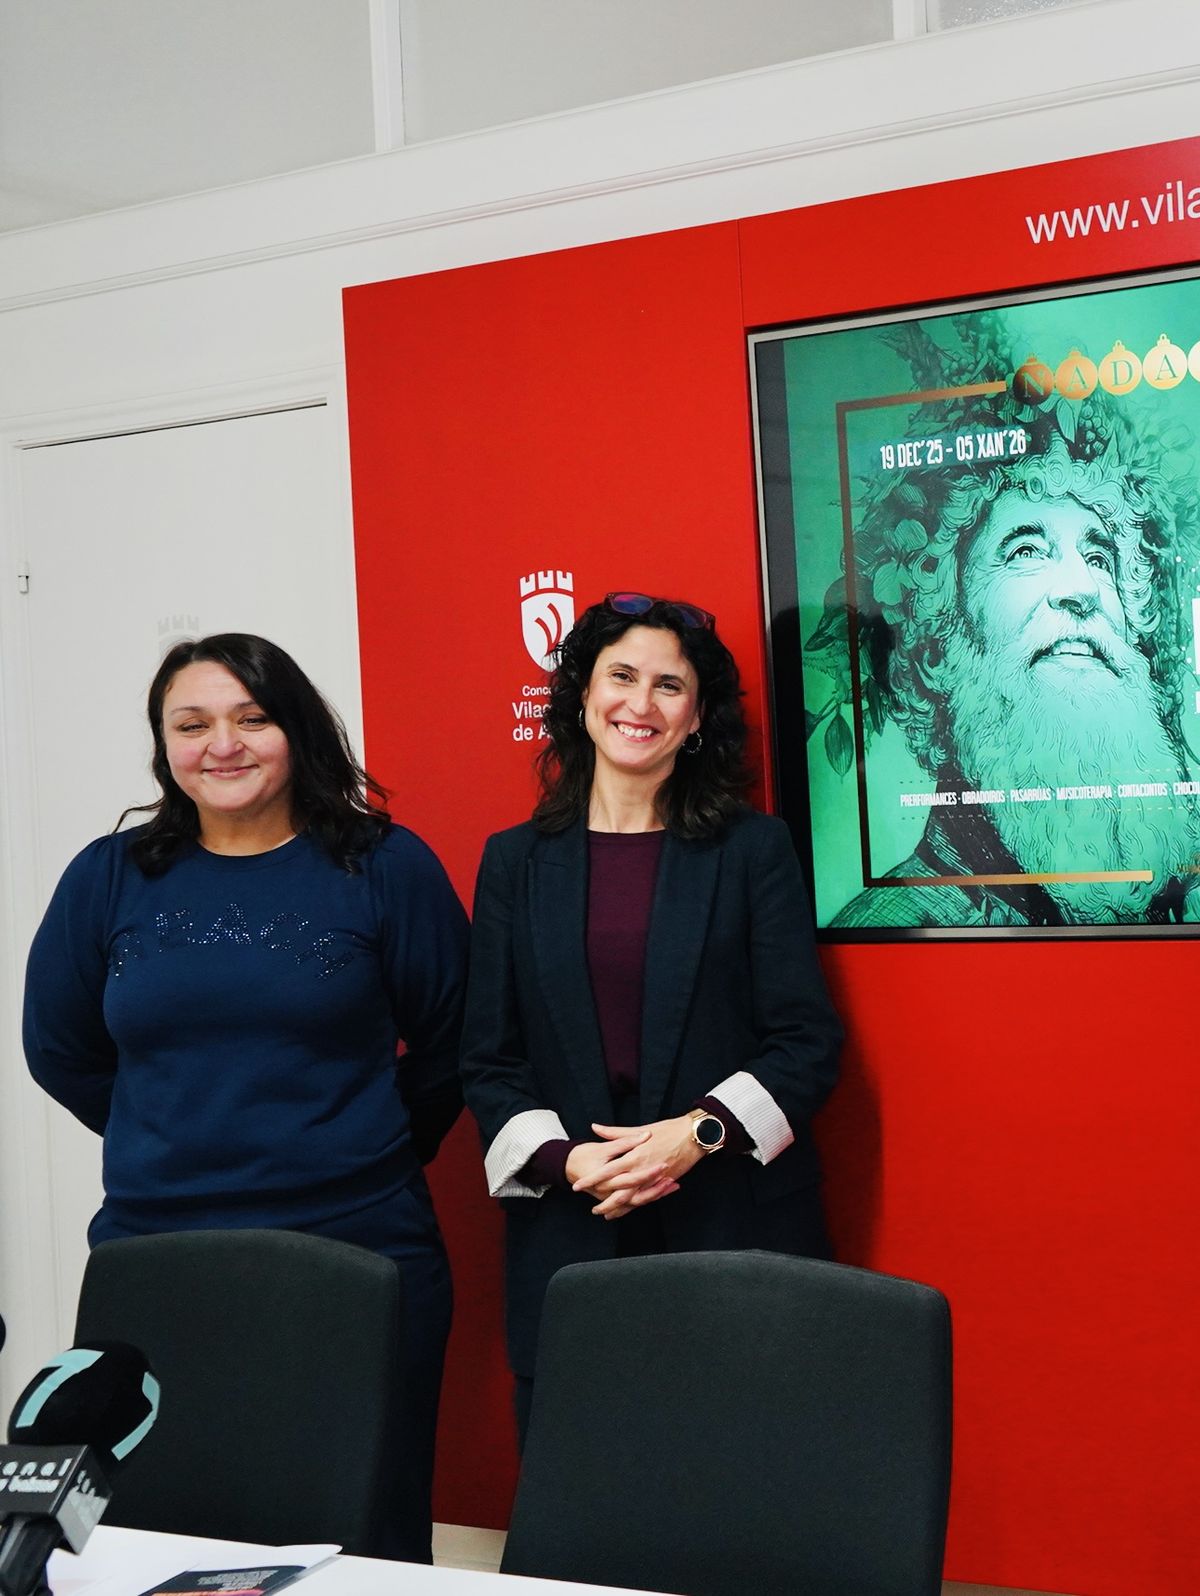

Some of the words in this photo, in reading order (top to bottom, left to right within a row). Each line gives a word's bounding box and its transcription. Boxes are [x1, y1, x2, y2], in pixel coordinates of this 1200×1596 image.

[880, 445, 894, 470] 19
[956, 435, 973, 461] 05
[513, 723, 533, 741] de
